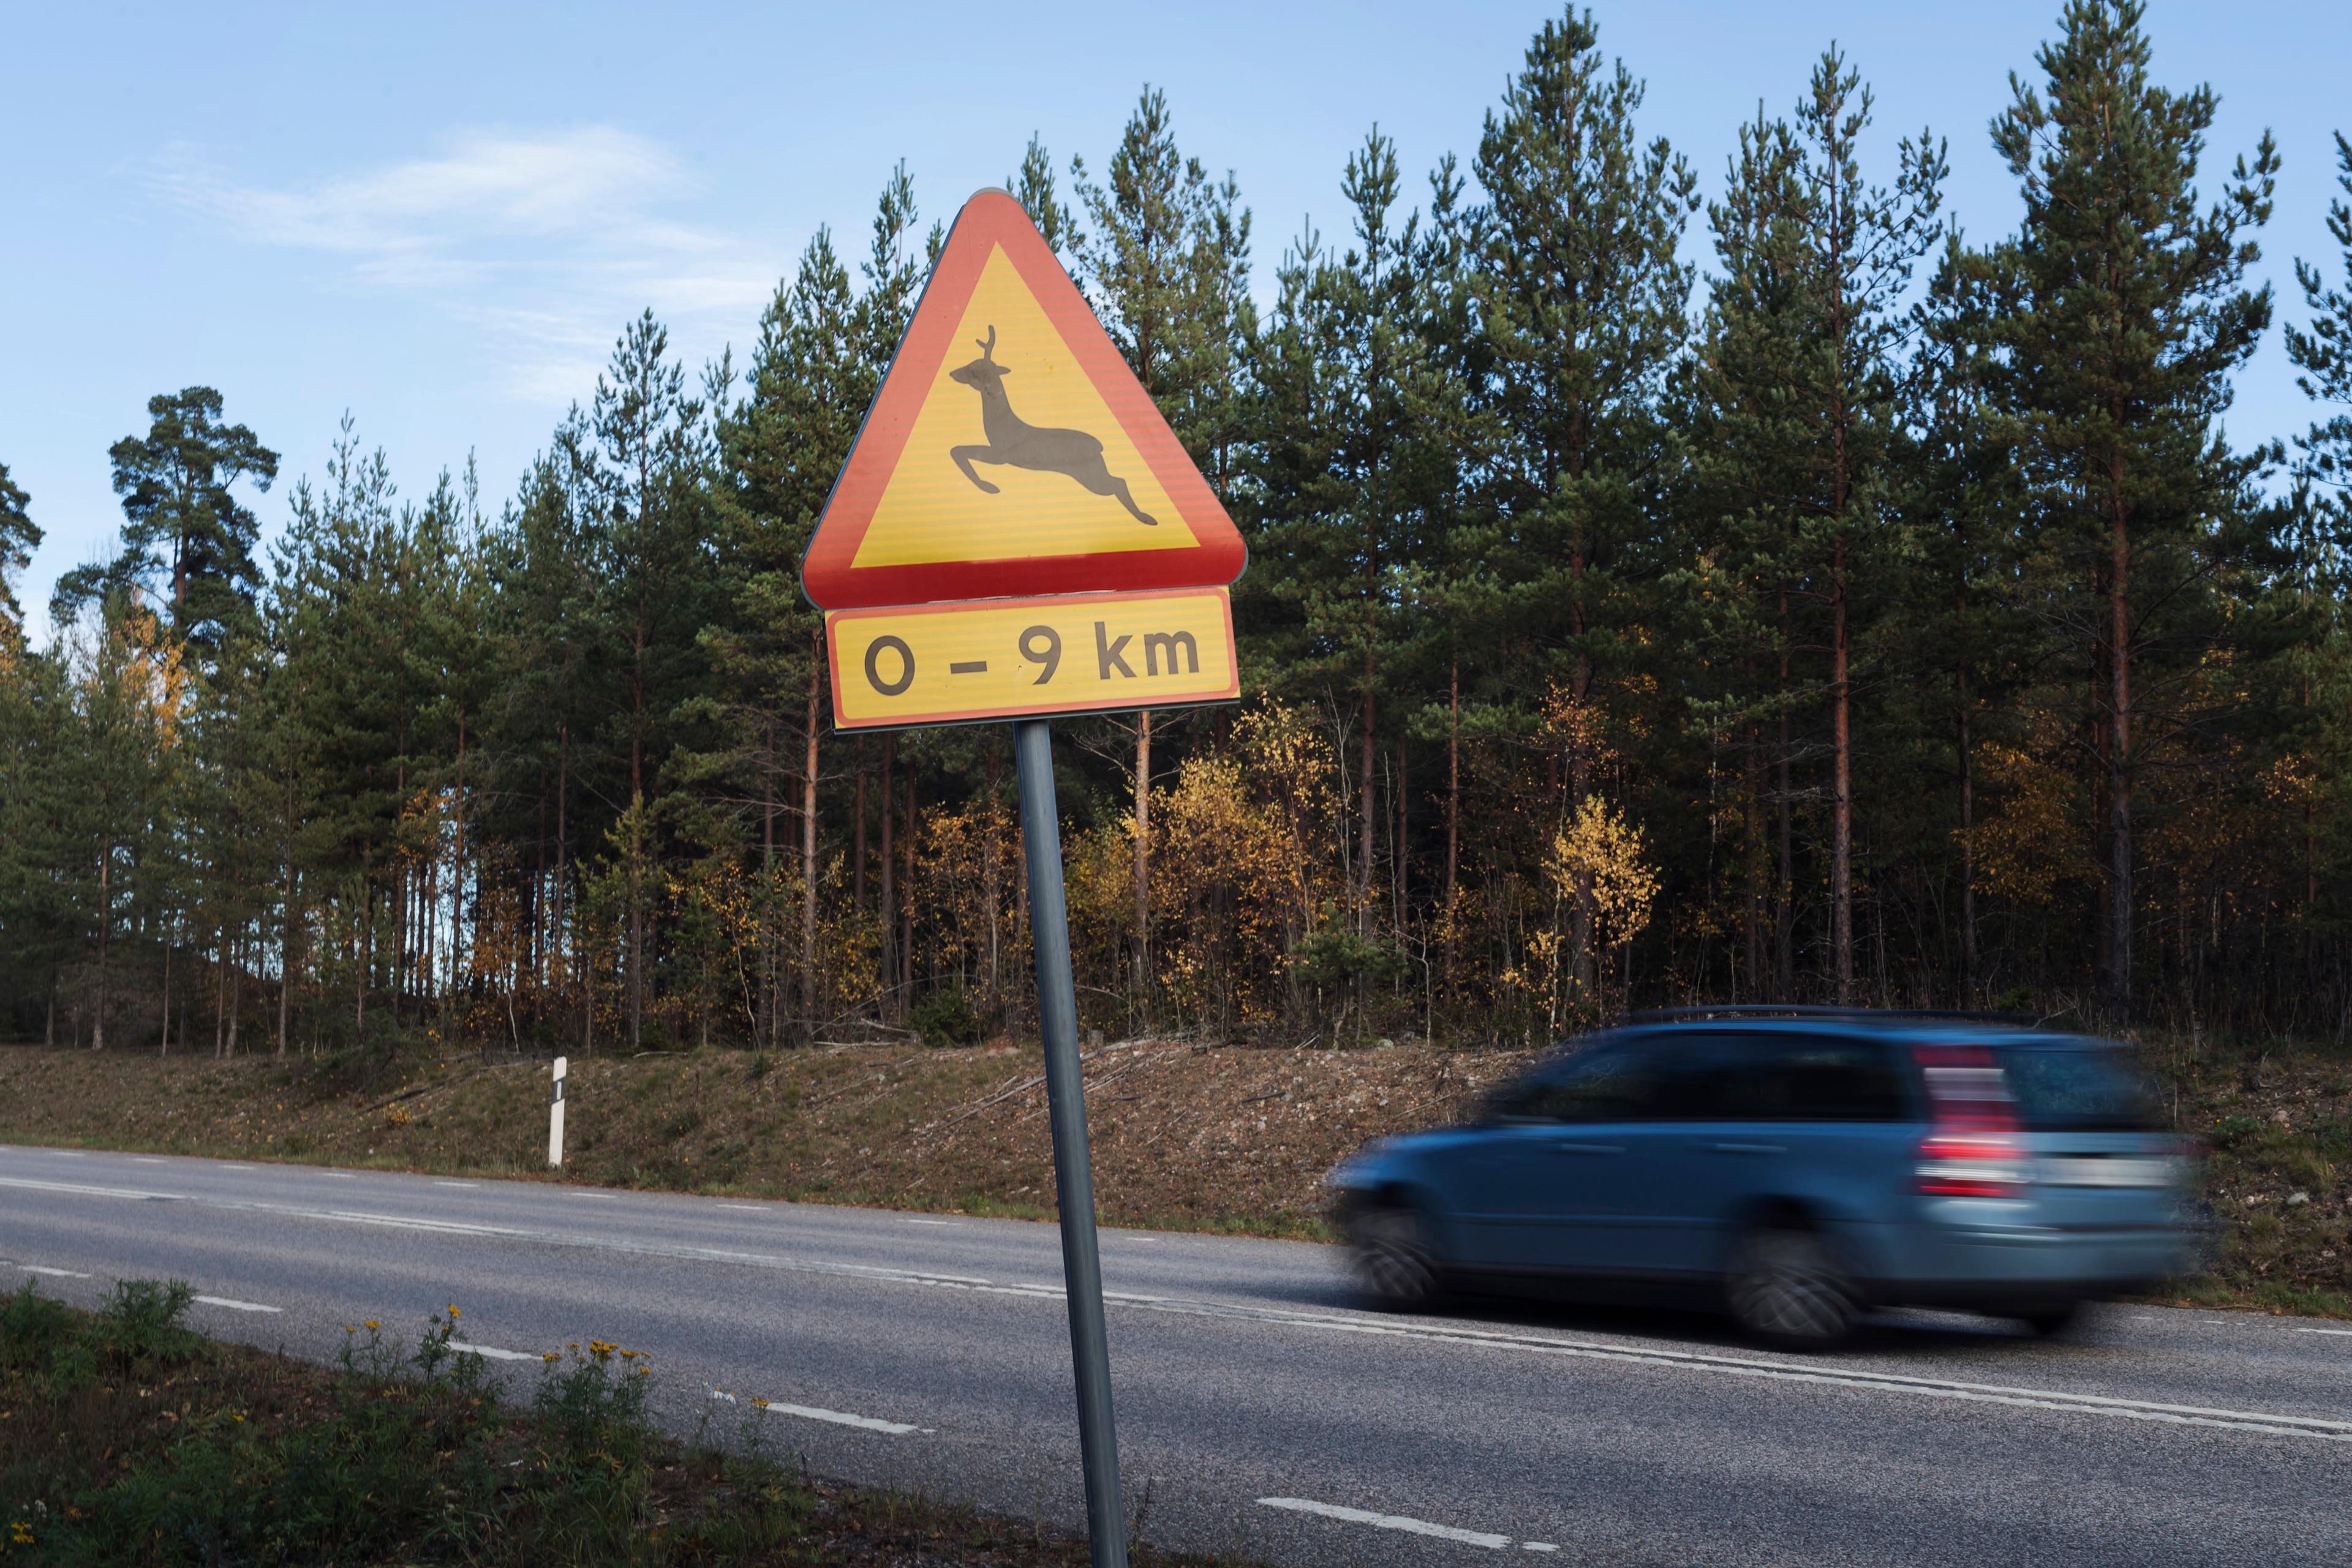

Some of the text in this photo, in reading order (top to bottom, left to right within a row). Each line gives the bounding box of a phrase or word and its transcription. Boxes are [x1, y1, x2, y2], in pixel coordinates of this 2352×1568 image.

[864, 635, 915, 696] 0
[1019, 625, 1061, 685] 9
[1094, 621, 1199, 680] km
